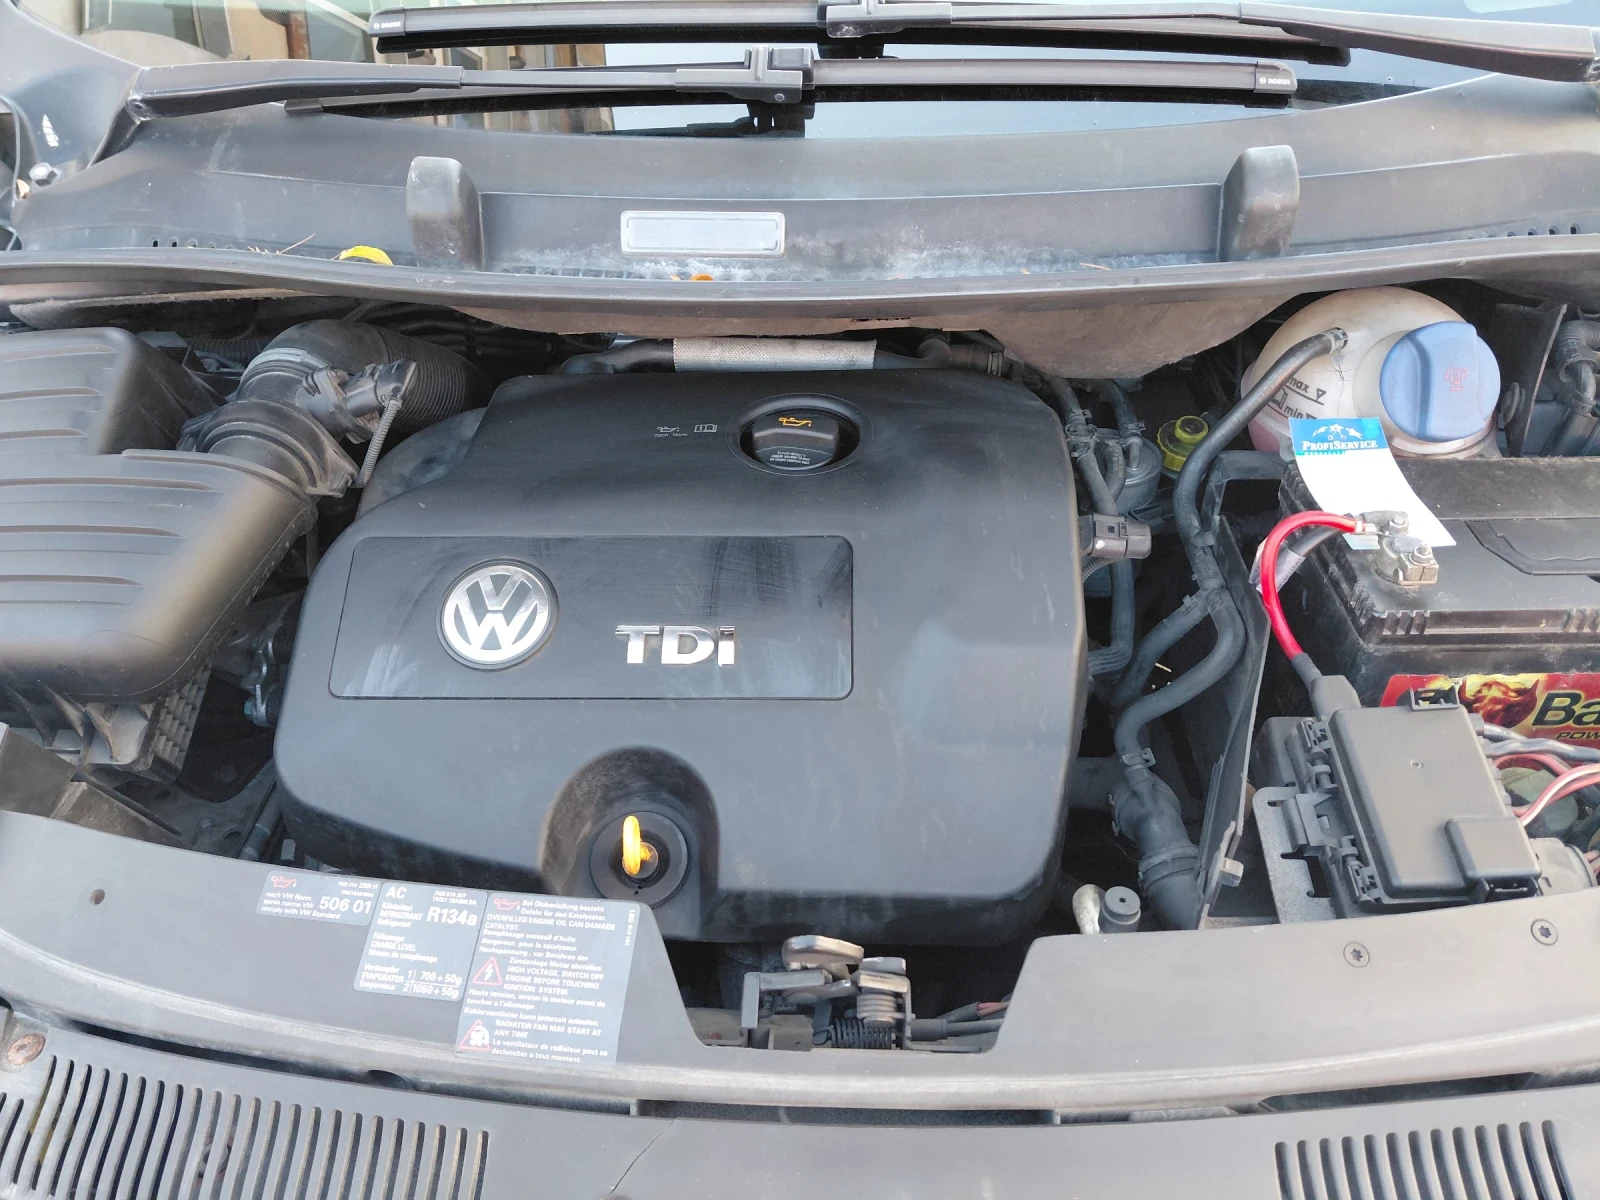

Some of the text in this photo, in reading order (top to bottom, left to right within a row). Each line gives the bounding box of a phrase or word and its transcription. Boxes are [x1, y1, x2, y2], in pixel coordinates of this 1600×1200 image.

[1284, 406, 1303, 419] min
[385, 886, 407, 899] AC
[319, 896, 372, 914] 506 01
[579, 904, 605, 912] besteht
[312, 910, 340, 919] Standard
[379, 910, 423, 920] REFRIGERANT
[427, 906, 477, 926] R134a
[521, 908, 542, 916] Gefahr
[487, 914, 528, 923] OVERFILLED
[529, 918, 554, 926] ENGINE
[584, 923, 616, 931] DAMAGE
[371, 940, 416, 952] CHARGE LEVEL
[481, 938, 515, 947] dangereux
[518, 941, 534, 949] pour
[368, 948, 391, 957] Niveau
[509, 957, 548, 968] Zündanlage
[549, 961, 569, 969] Motor
[507, 966, 525, 974] HIGH
[361, 971, 404, 983] EVAPORATOR
[408, 970, 412, 978] 1
[420, 971, 436, 981] 700
[445, 974, 463, 985] 50g
[505, 975, 600, 989] ENGINE BEFORE TOUCHING
[403, 983, 410, 992] 2
[413, 984, 432, 994] 1050
[441, 987, 459, 999] 50g
[504, 984, 535, 993] IGNITION
[467, 997, 493, 1006] toucher
[468, 988, 489, 997] Haute
[575, 999, 596, 1007] avant
[464, 1007, 518, 1019] Kühlerventilator
[519, 1012, 536, 1020] kann
[537, 1014, 567, 1024] jederzeit
[494, 1029, 509, 1037] ANY
[496, 1020, 602, 1037] RADIATOR FAN MAY START AT
[502, 1040, 539, 1049] ventilateur
[550, 1045, 581, 1054] radiateur
[582, 1048, 598, 1056] peut
